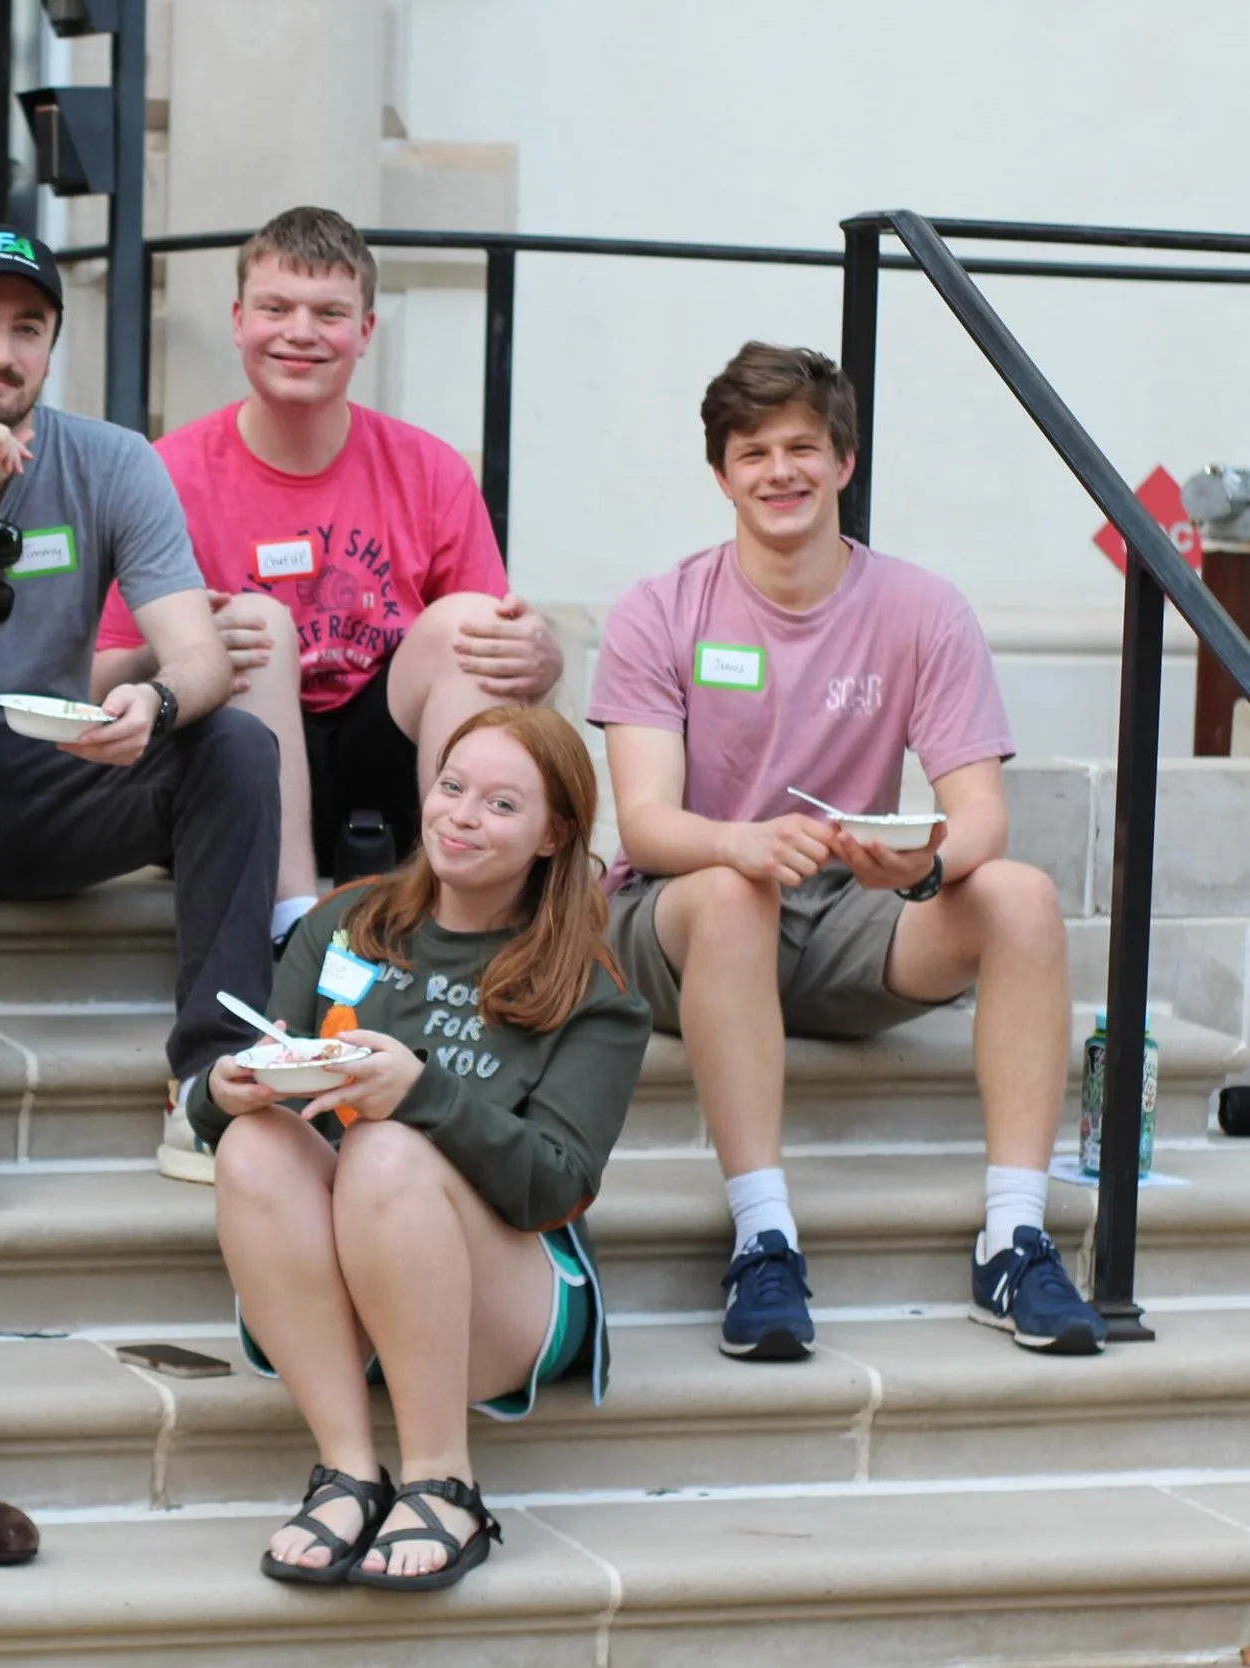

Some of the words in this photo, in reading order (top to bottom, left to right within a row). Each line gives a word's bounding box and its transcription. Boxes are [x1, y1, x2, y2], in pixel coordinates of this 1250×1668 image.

[345, 529, 400, 619] SHACK
[423, 1008, 485, 1042] FOR
[436, 1044, 501, 1079] YOU
